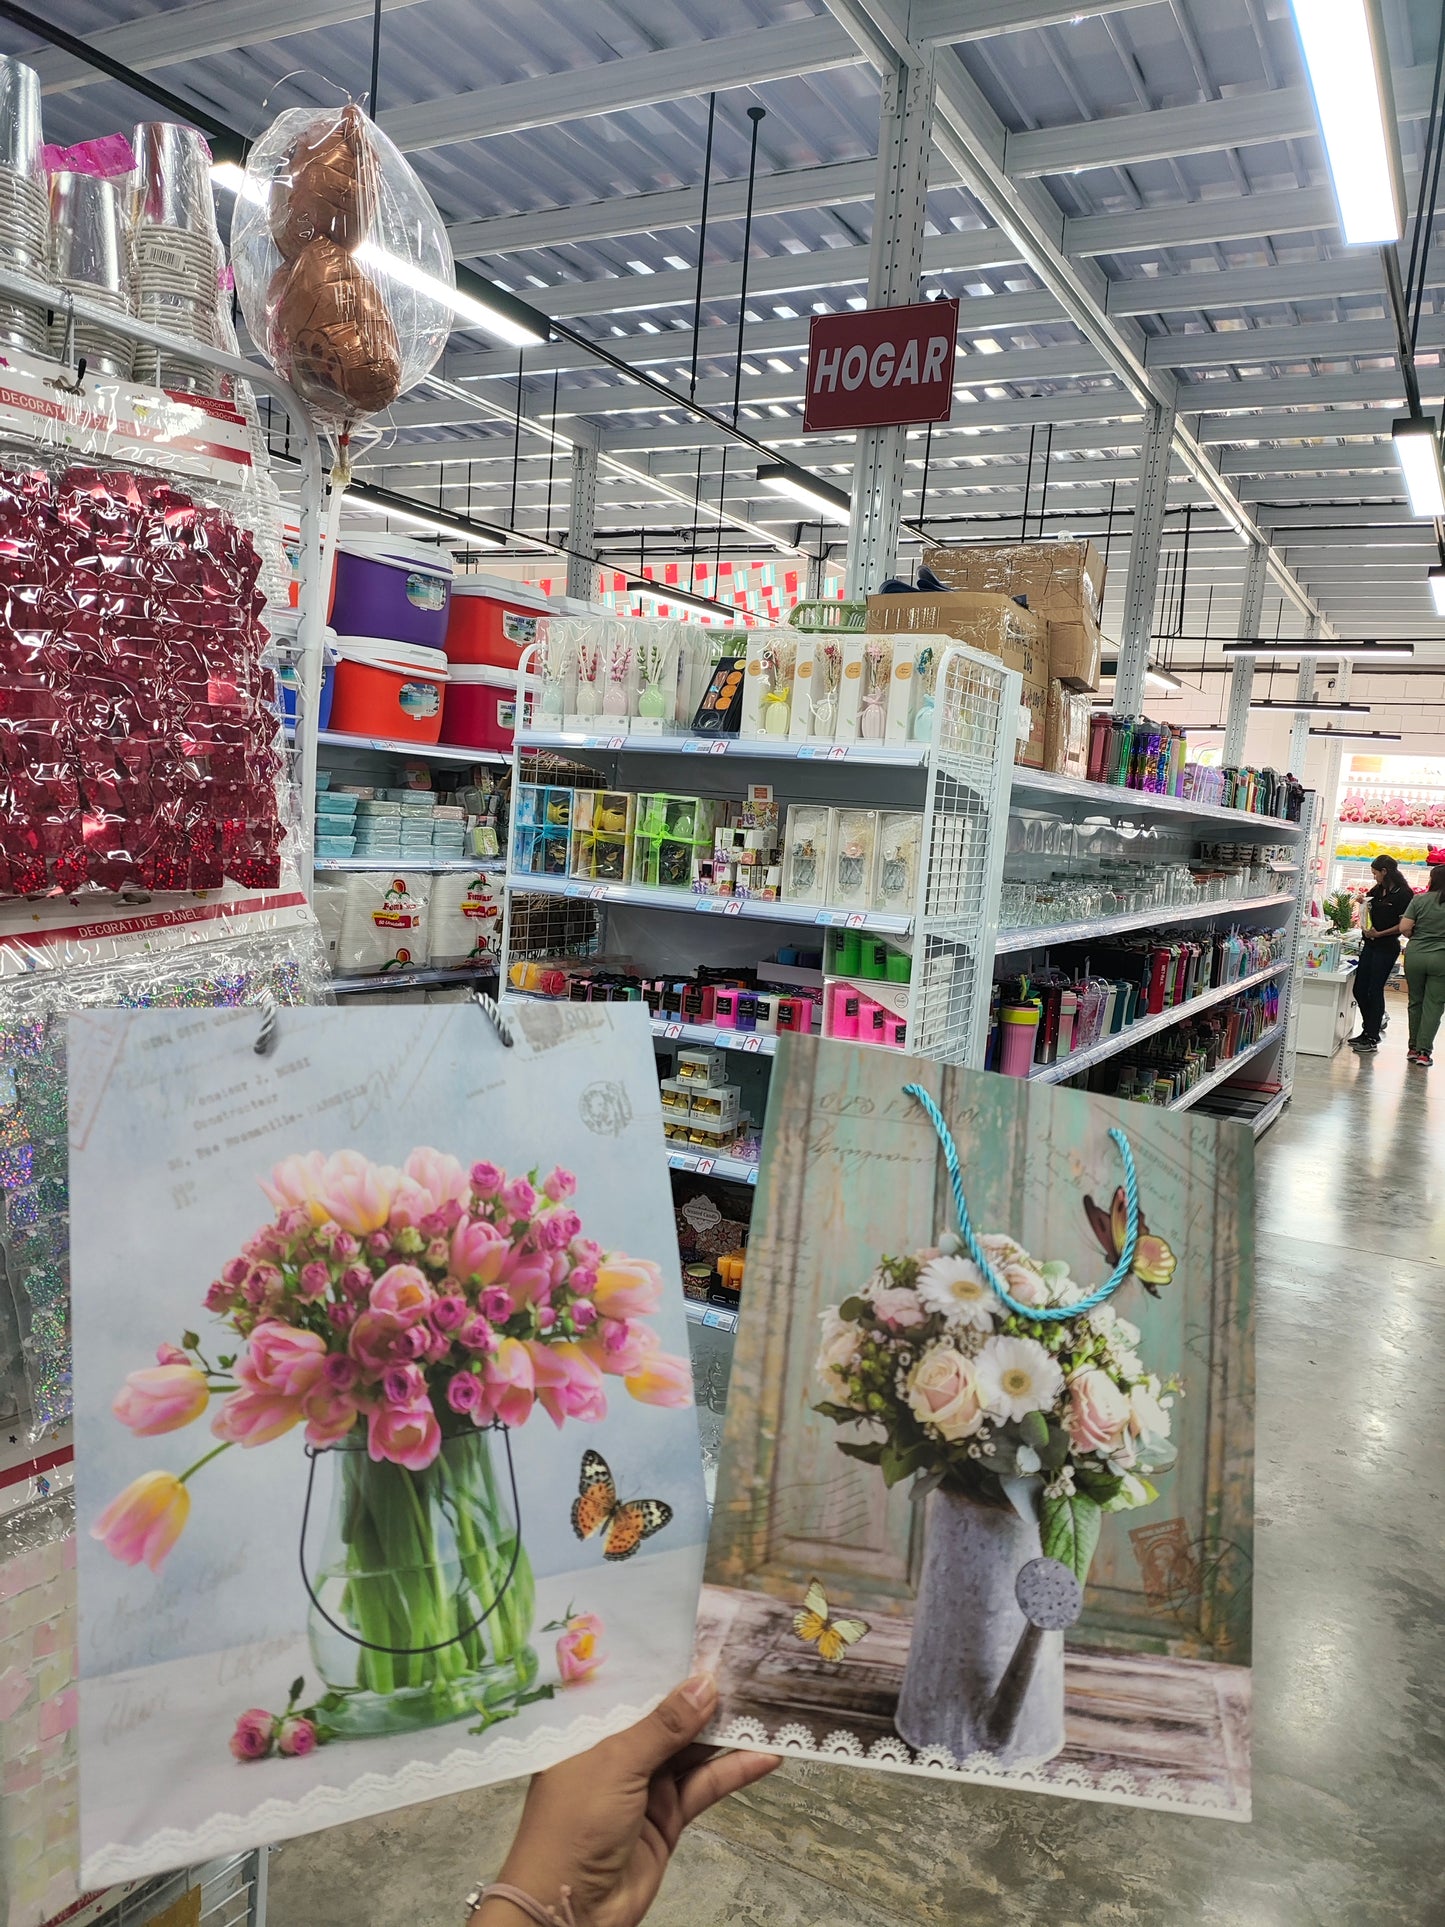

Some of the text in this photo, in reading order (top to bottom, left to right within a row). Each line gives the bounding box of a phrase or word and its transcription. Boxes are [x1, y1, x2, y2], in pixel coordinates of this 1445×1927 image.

[813, 336, 949, 394] HOGAR
[192, 396, 227, 410] 30x30cm
[78, 908, 202, 939] DECORATIVE PANEL
